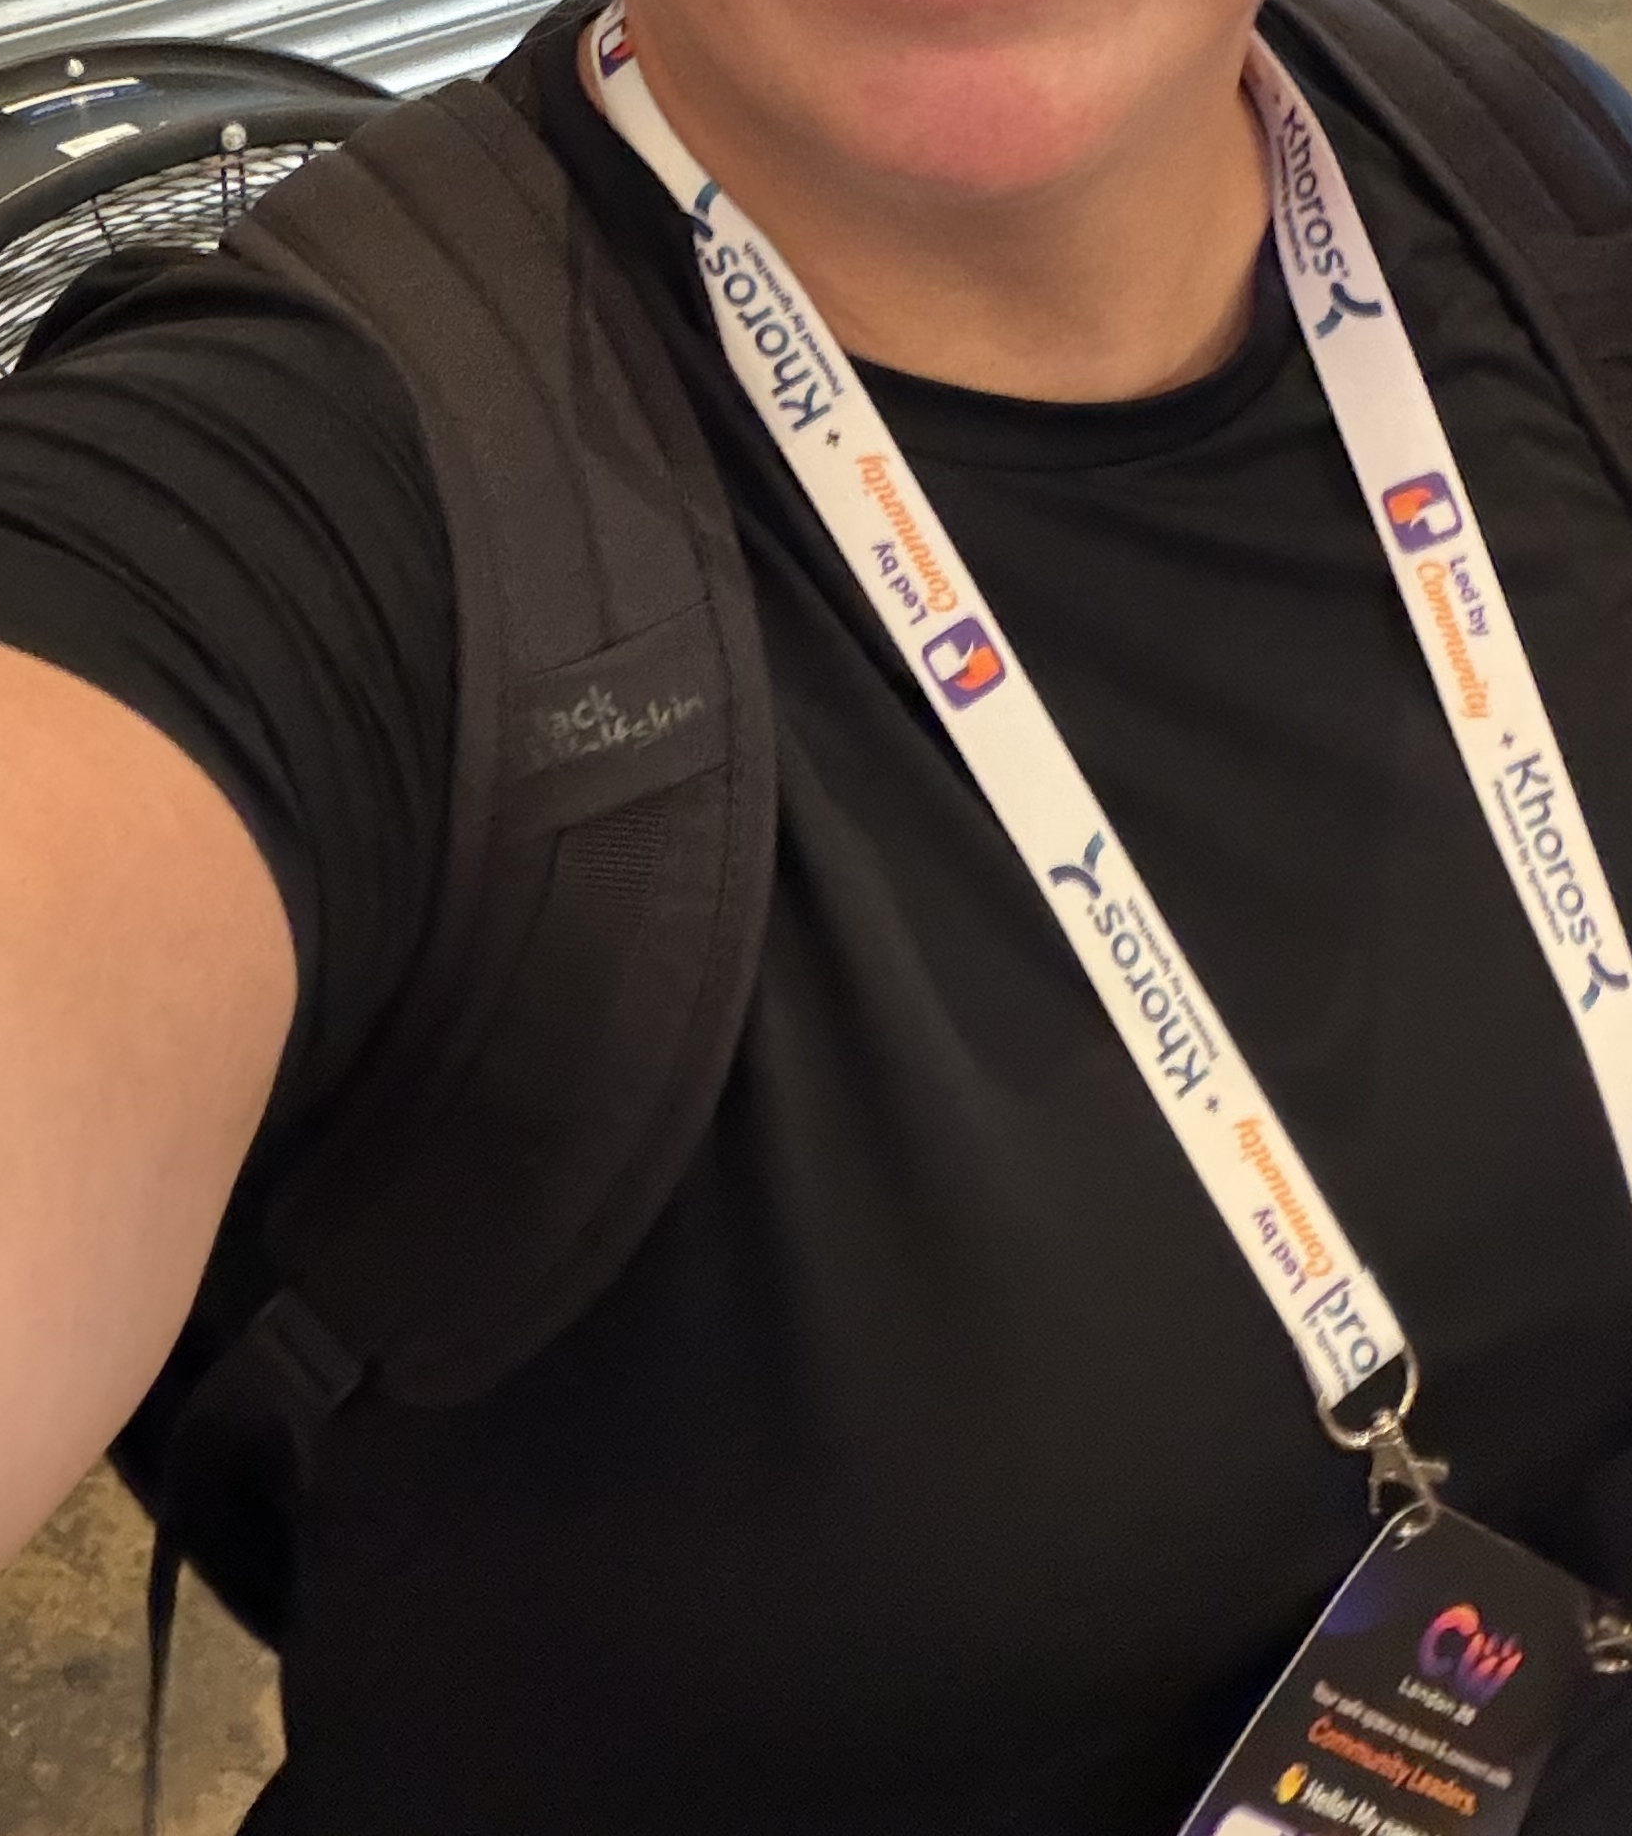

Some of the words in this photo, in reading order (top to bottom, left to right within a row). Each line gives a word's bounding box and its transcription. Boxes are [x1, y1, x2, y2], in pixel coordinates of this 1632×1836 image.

[1284, 106, 1344, 276] Khoros
[706, 245, 834, 431] Khoros
[855, 454, 958, 613] Community
[872, 541, 899, 576] by
[888, 575, 928, 626] Led
[1450, 555, 1480, 604] Led
[1467, 605, 1489, 637] by
[1417, 560, 1492, 719] Community
[1506, 752, 1598, 945] Khoros
[1094, 903, 1209, 1100] Khoros
[1234, 1116, 1334, 1278] Community
[1253, 1207, 1277, 1245] by
[1272, 1243, 1307, 1295] Led
[1308, 1714, 1412, 1788] Community
